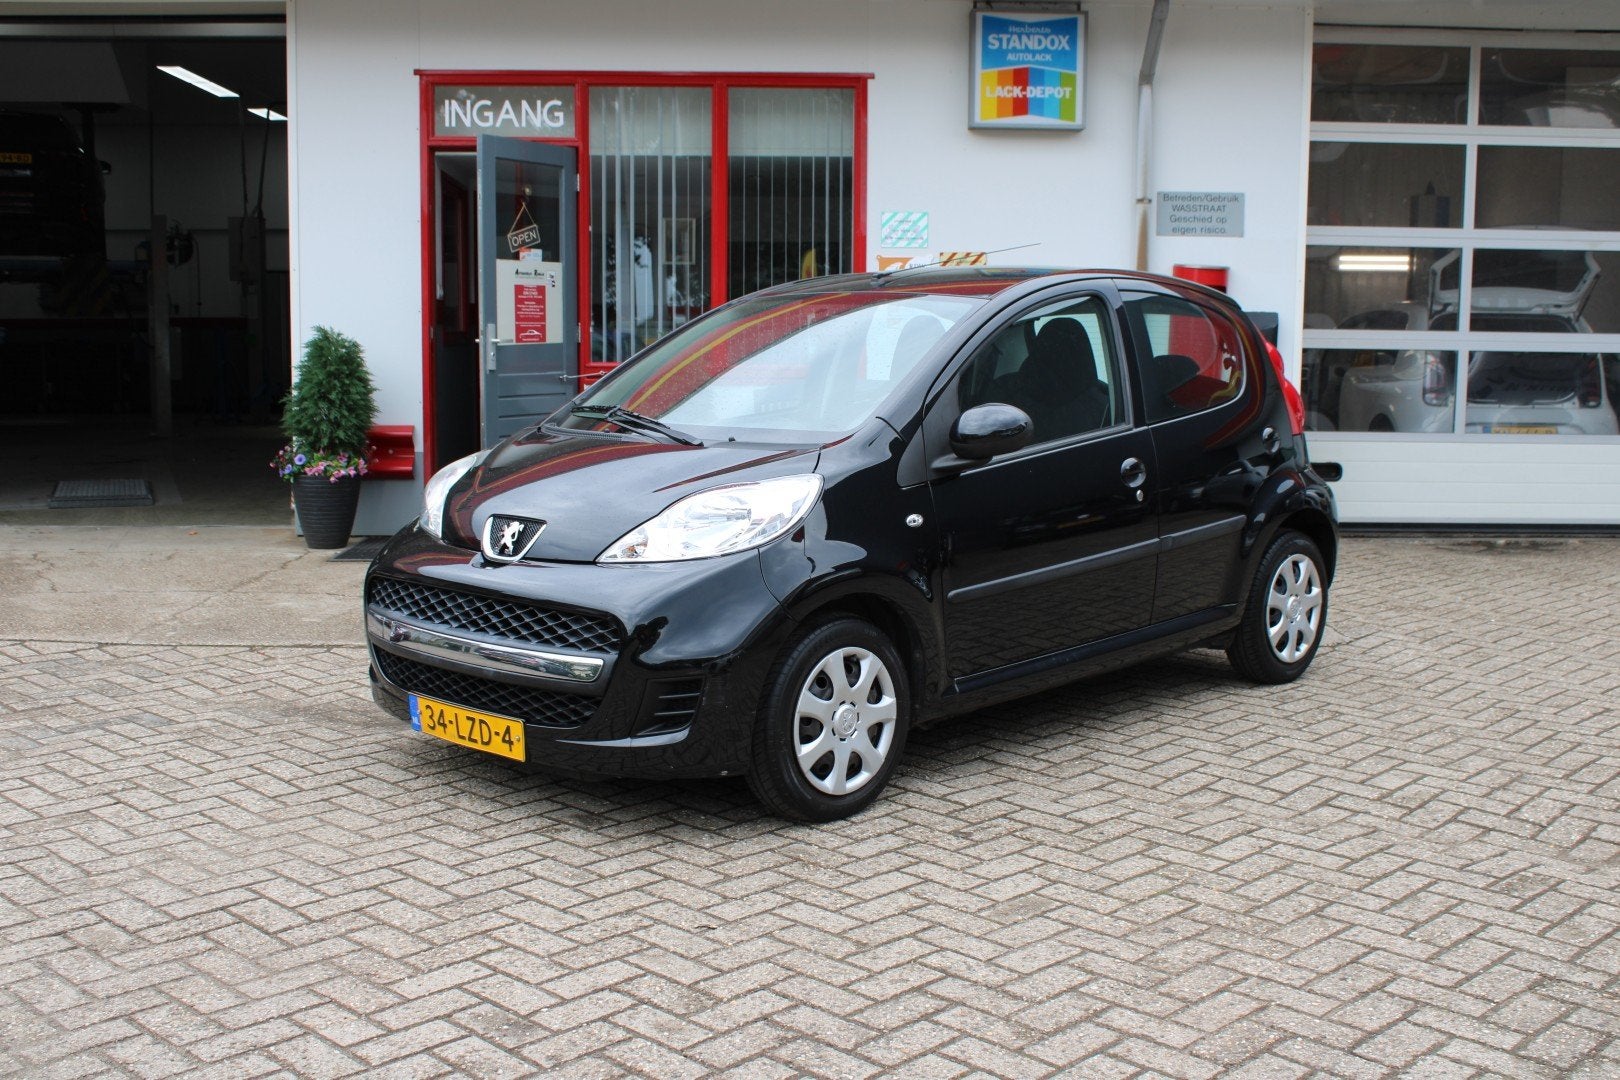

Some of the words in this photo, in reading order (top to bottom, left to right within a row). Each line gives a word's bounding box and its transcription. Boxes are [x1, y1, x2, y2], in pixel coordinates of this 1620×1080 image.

[988, 34, 1071, 50] STANDOX
[1006, 53, 1052, 61] AUTOLACK
[985, 85, 1072, 99] LACK-DEPOT
[444, 99, 565, 128] INGANG
[1163, 193, 1239, 203] Betreden/Gebruik
[1172, 204, 1226, 213] WASSTRAAT
[1169, 214, 1213, 223] Geschied
[1171, 225, 1197, 235] eigen
[511, 229, 537, 248] OPEN
[425, 704, 514, 752] 34-LZD-4
